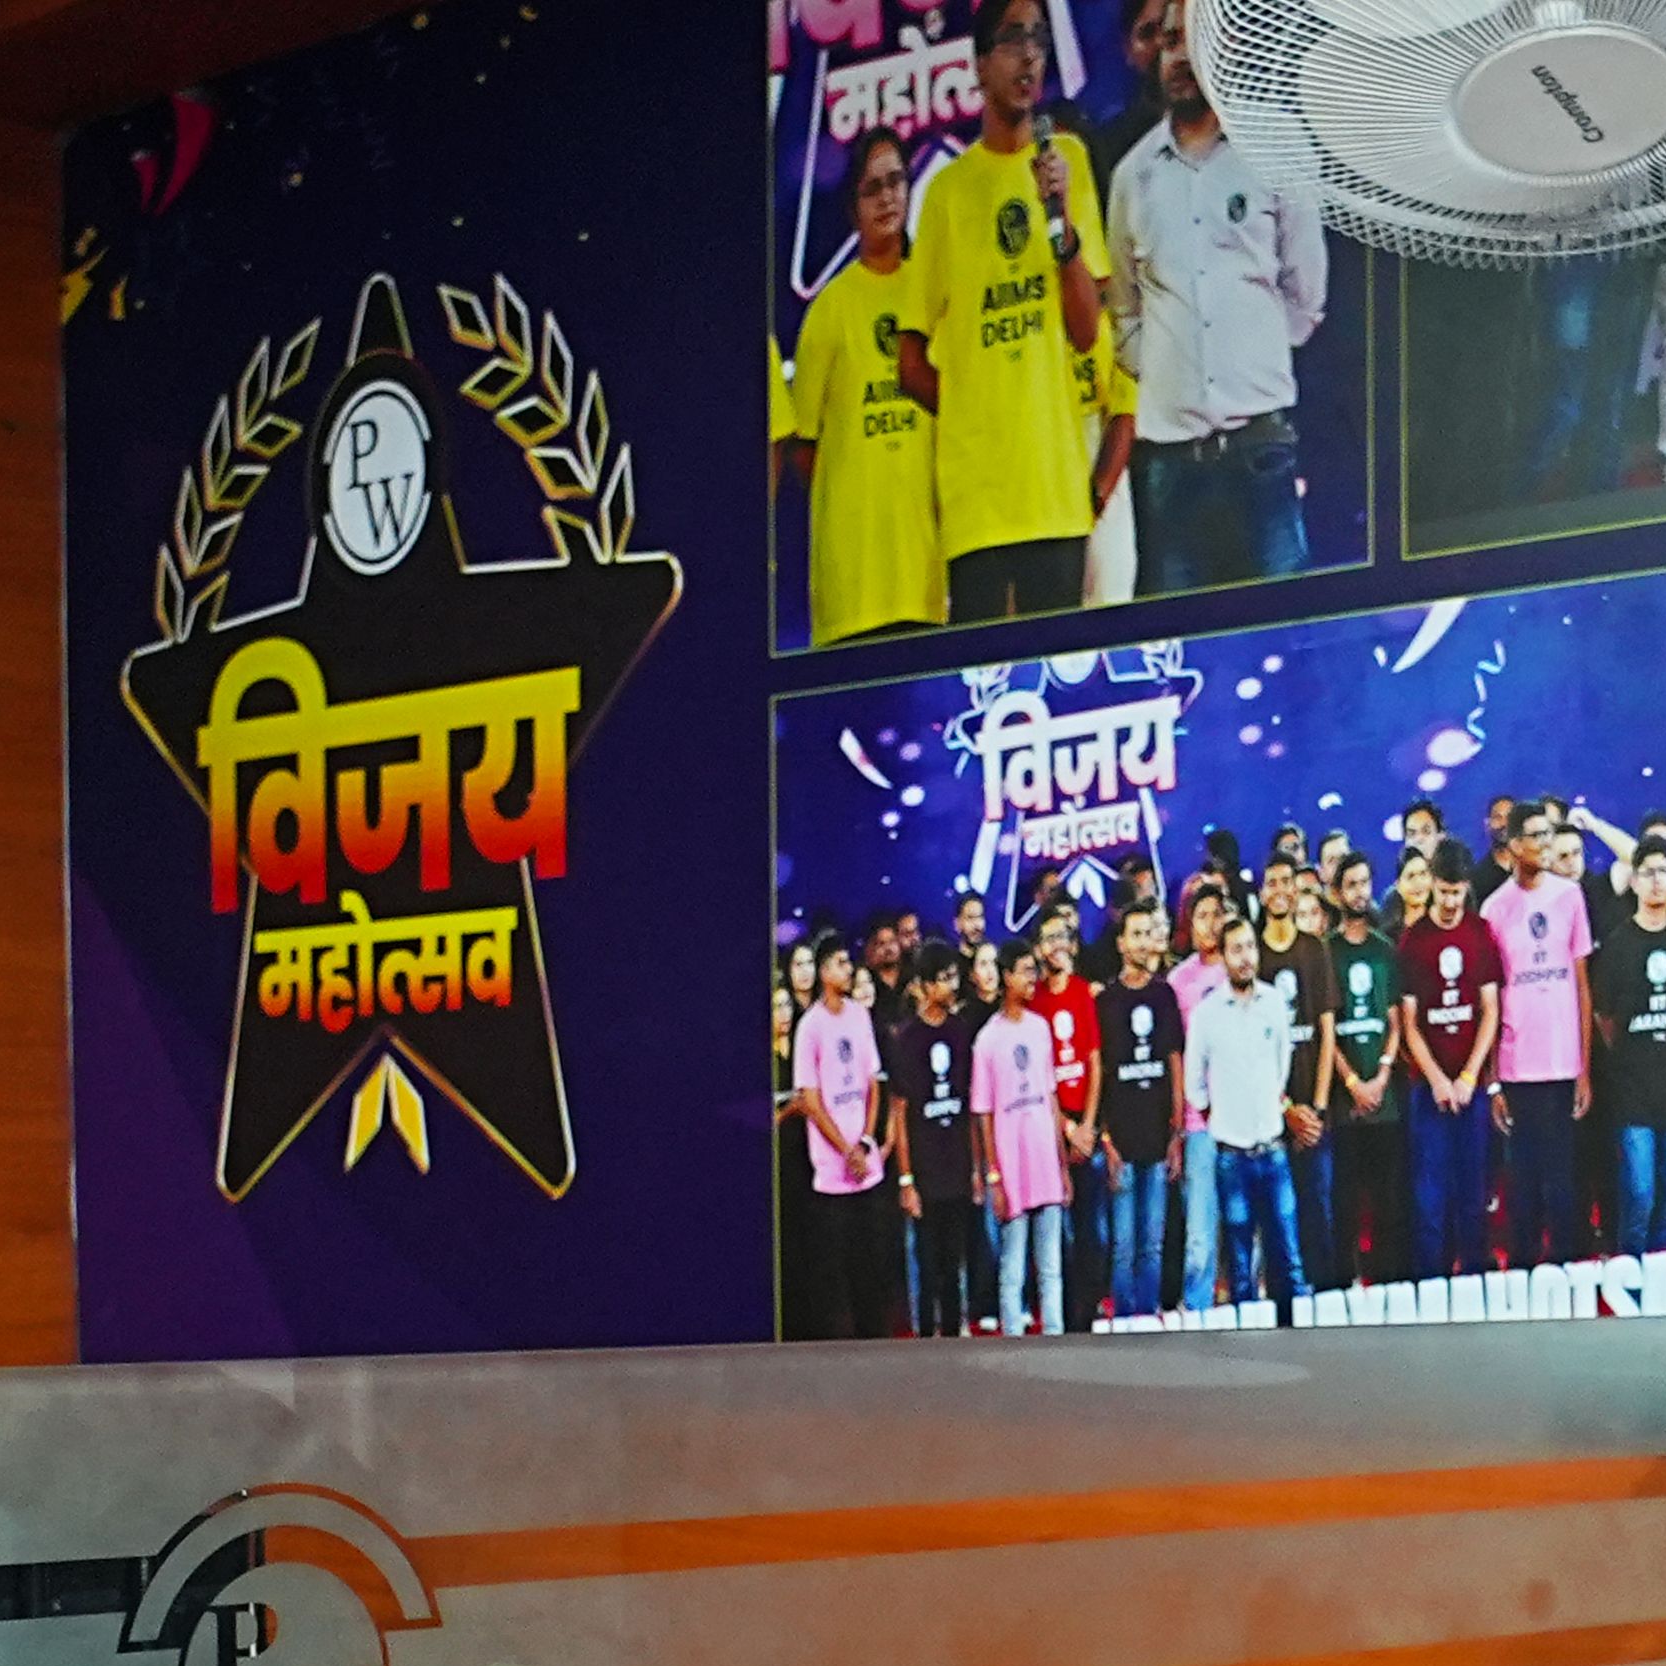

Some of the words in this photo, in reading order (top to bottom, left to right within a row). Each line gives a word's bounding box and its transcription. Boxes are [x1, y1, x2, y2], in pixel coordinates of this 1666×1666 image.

[1531, 65, 1604, 142] Crompton
[195, 635, 581, 914] विजय
[977, 690, 1182, 820] विजय
[254, 889, 519, 1034] महोत्सव
